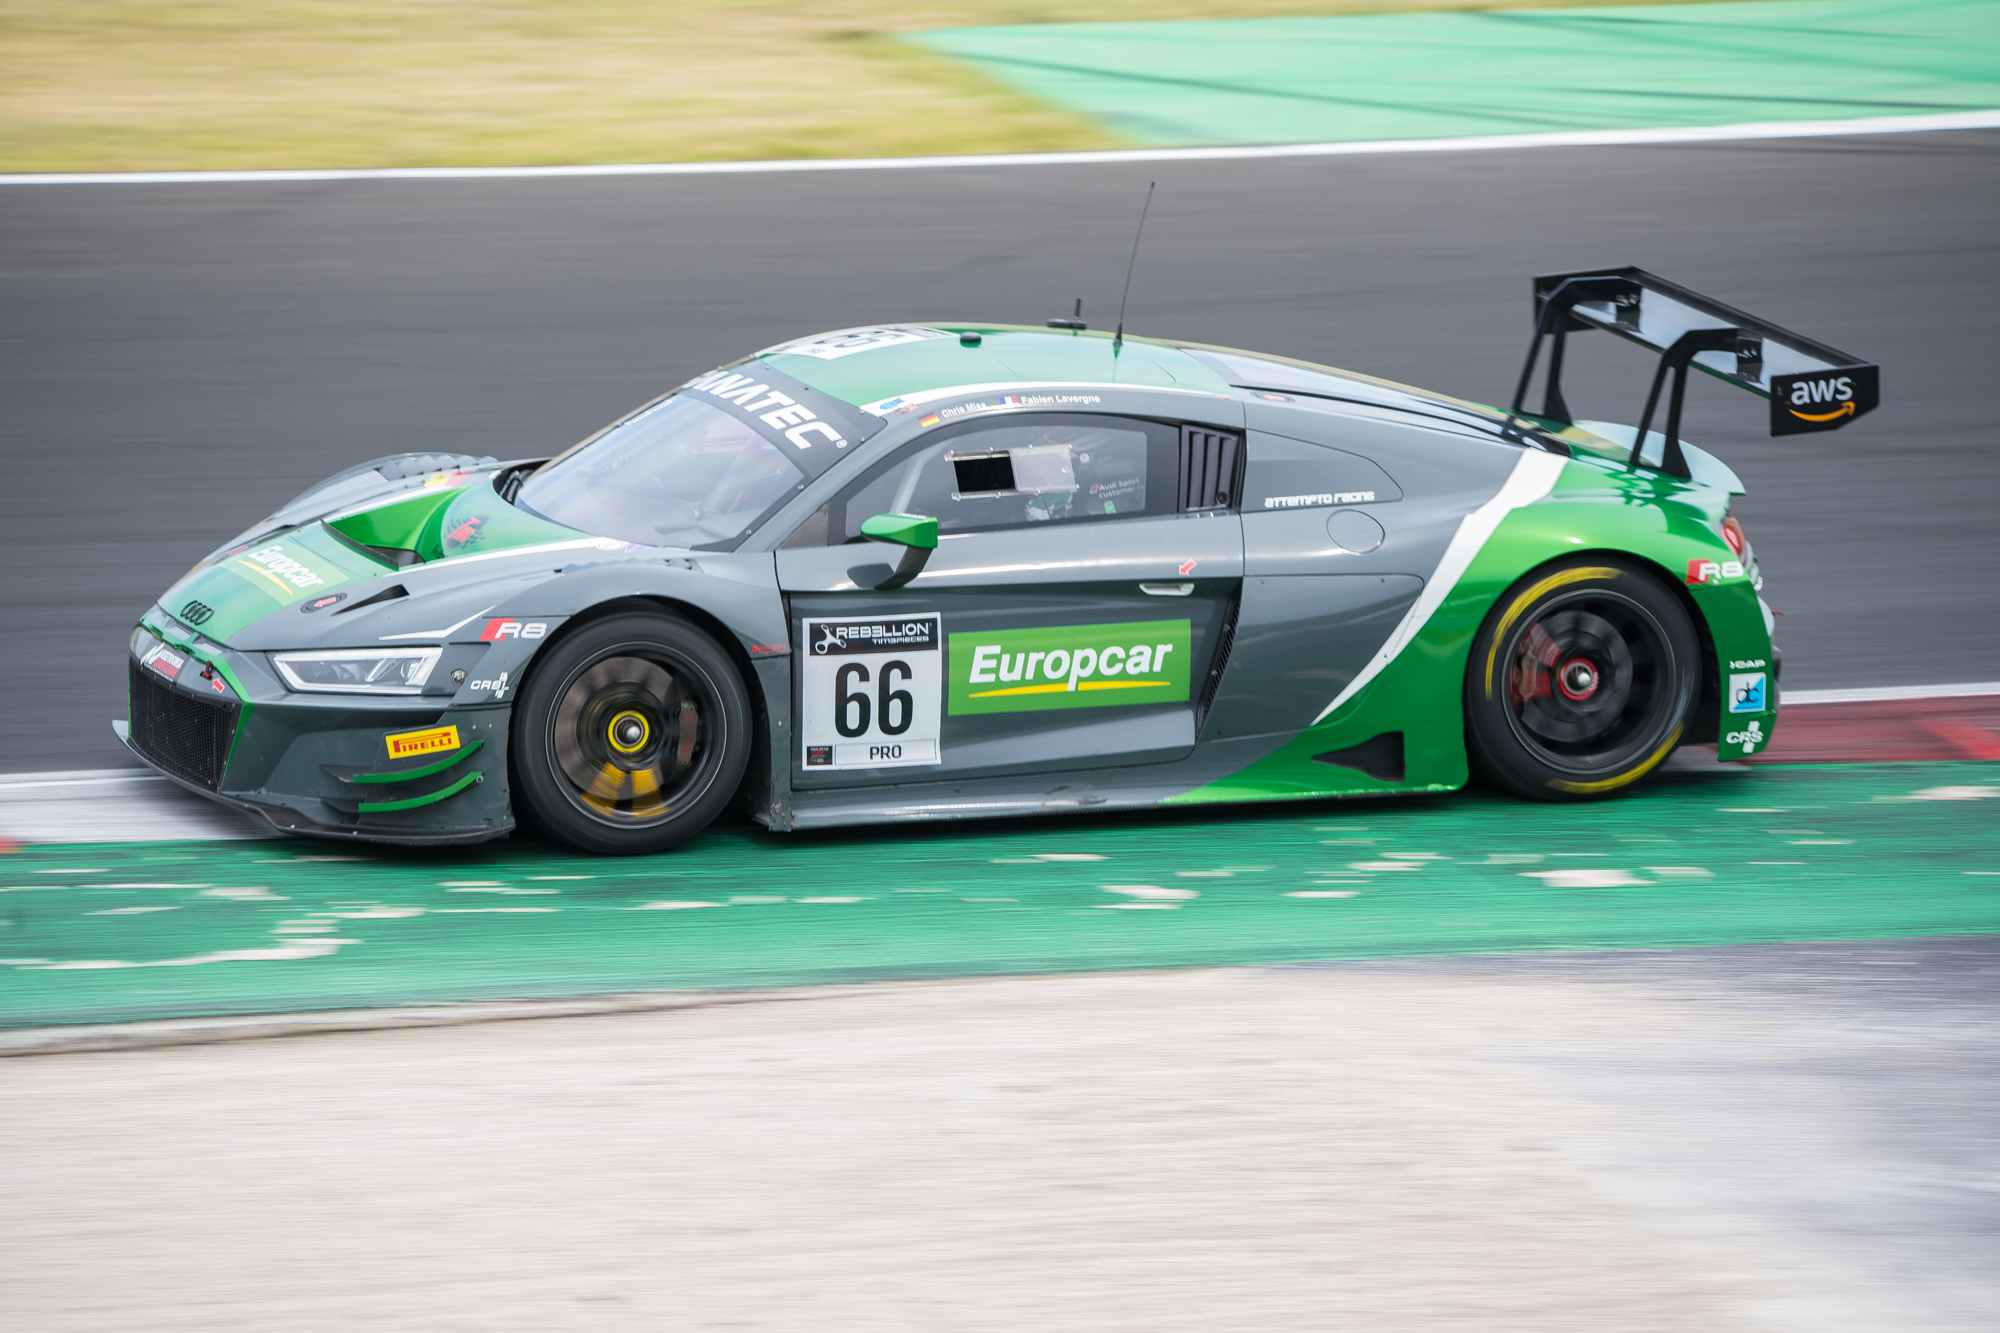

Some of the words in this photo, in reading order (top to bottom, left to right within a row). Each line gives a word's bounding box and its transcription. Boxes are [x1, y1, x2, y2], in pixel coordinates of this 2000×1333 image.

[1020, 395, 1054, 405] Fabien
[1791, 376, 1853, 406] aws
[941, 405, 966, 418] Chris
[1099, 481, 1117, 491] Audi
[1119, 478, 1140, 488] Sport
[248, 545, 324, 588] Europcar
[1698, 561, 1744, 581] R8
[495, 622, 548, 639] R8
[836, 622, 929, 639] REBELLION
[969, 643, 1173, 692] Europcar
[834, 660, 914, 738] 66
[393, 731, 452, 754] PIRELLI
[869, 744, 903, 761] PRO
